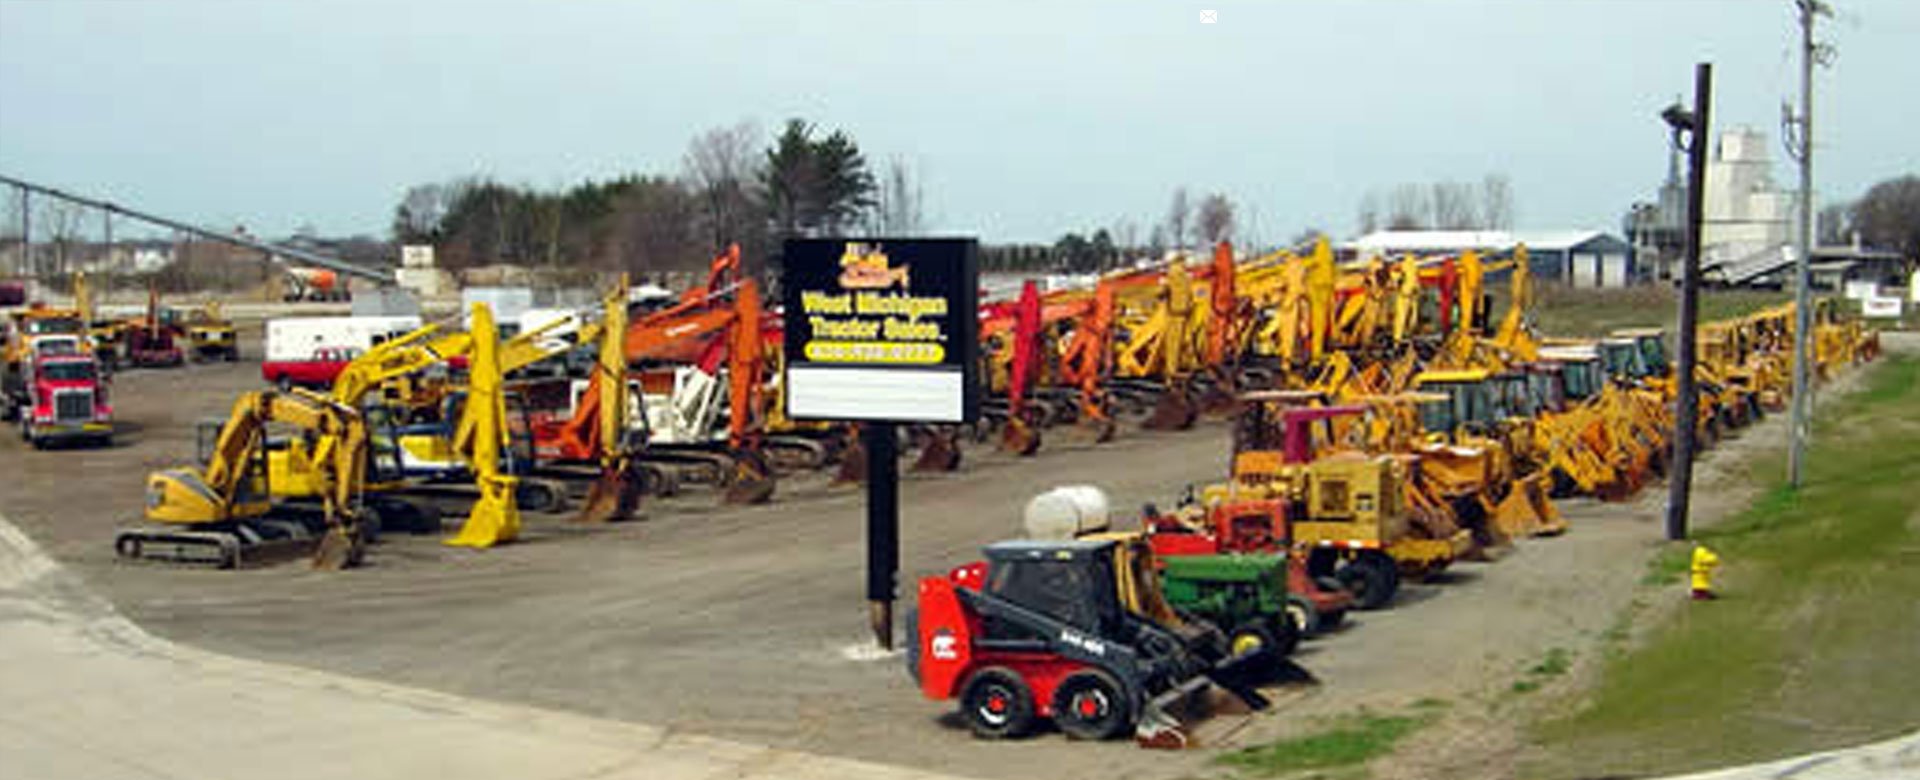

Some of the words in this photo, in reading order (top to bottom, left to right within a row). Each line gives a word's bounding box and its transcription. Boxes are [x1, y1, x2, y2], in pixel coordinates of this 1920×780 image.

[801, 291, 851, 314] West
[856, 291, 948, 319] Michigan
[809, 316, 880, 339] Tractor
